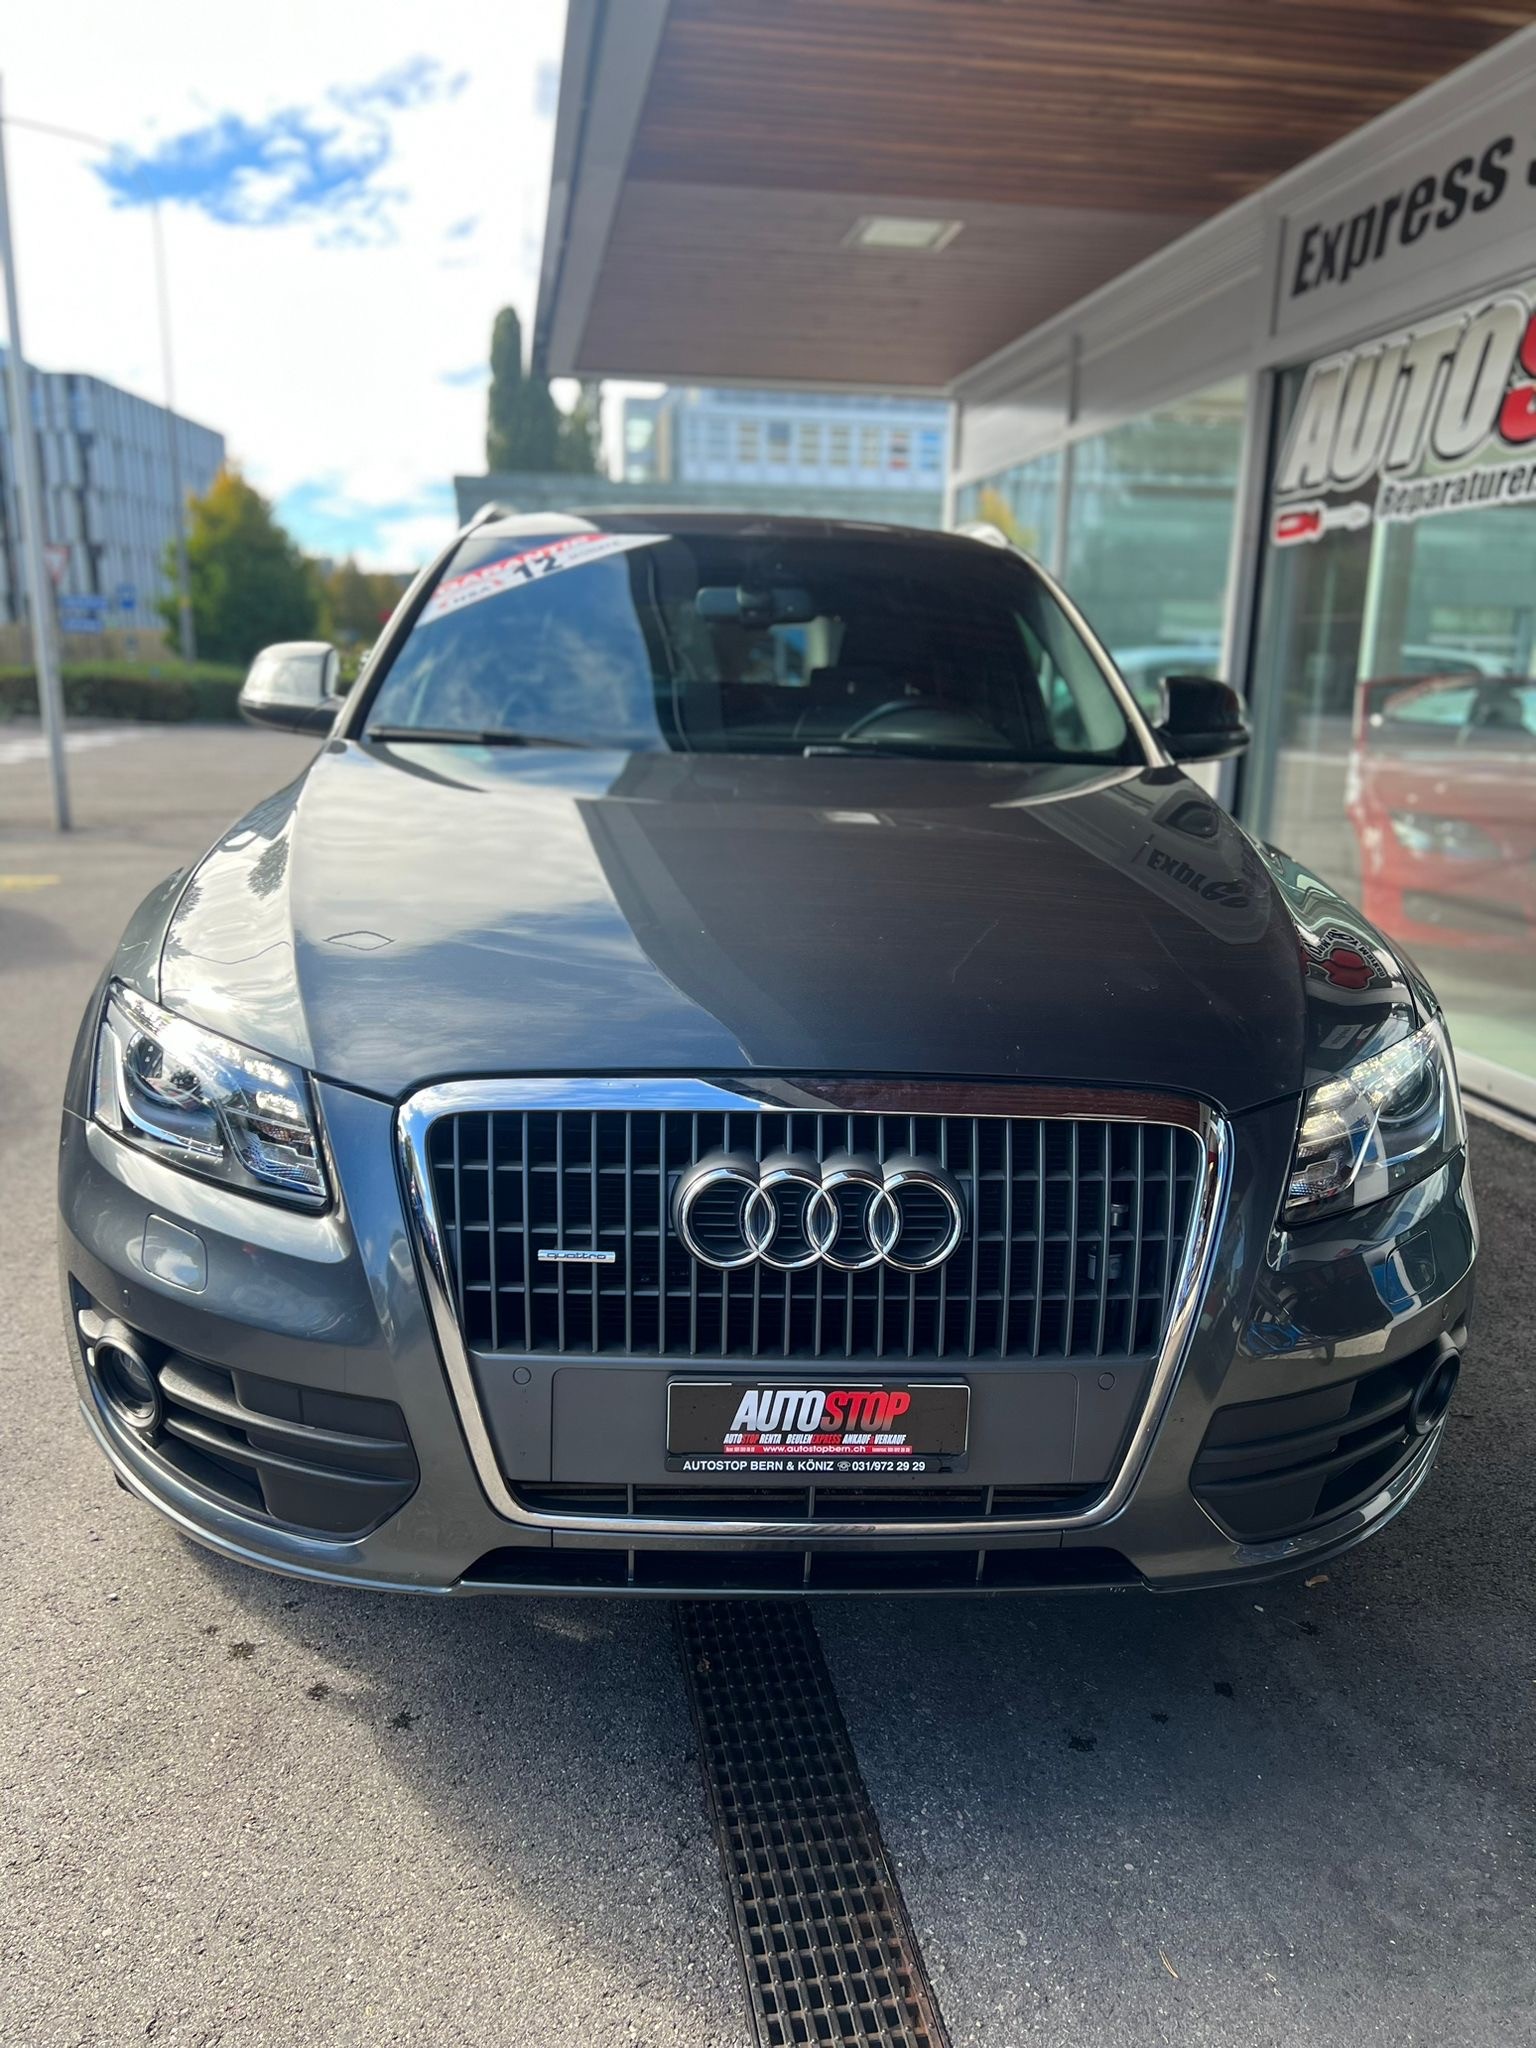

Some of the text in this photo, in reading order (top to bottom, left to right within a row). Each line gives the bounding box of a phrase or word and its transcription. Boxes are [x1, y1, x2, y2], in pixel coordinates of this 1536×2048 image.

[1291, 135, 1514, 298] Express
[546, 1252, 606, 1260] quattro
[729, 1389, 911, 1432] AUTOSTOP
[723, 1433, 759, 1444] AUTOSTOP
[759, 1433, 782, 1444] RENTA
[763, 1445, 866, 1454] www.autostopbern.ch
[683, 1458, 926, 1472] AUTOSTOP BERN & KÖNIZ 031/972 29 29
